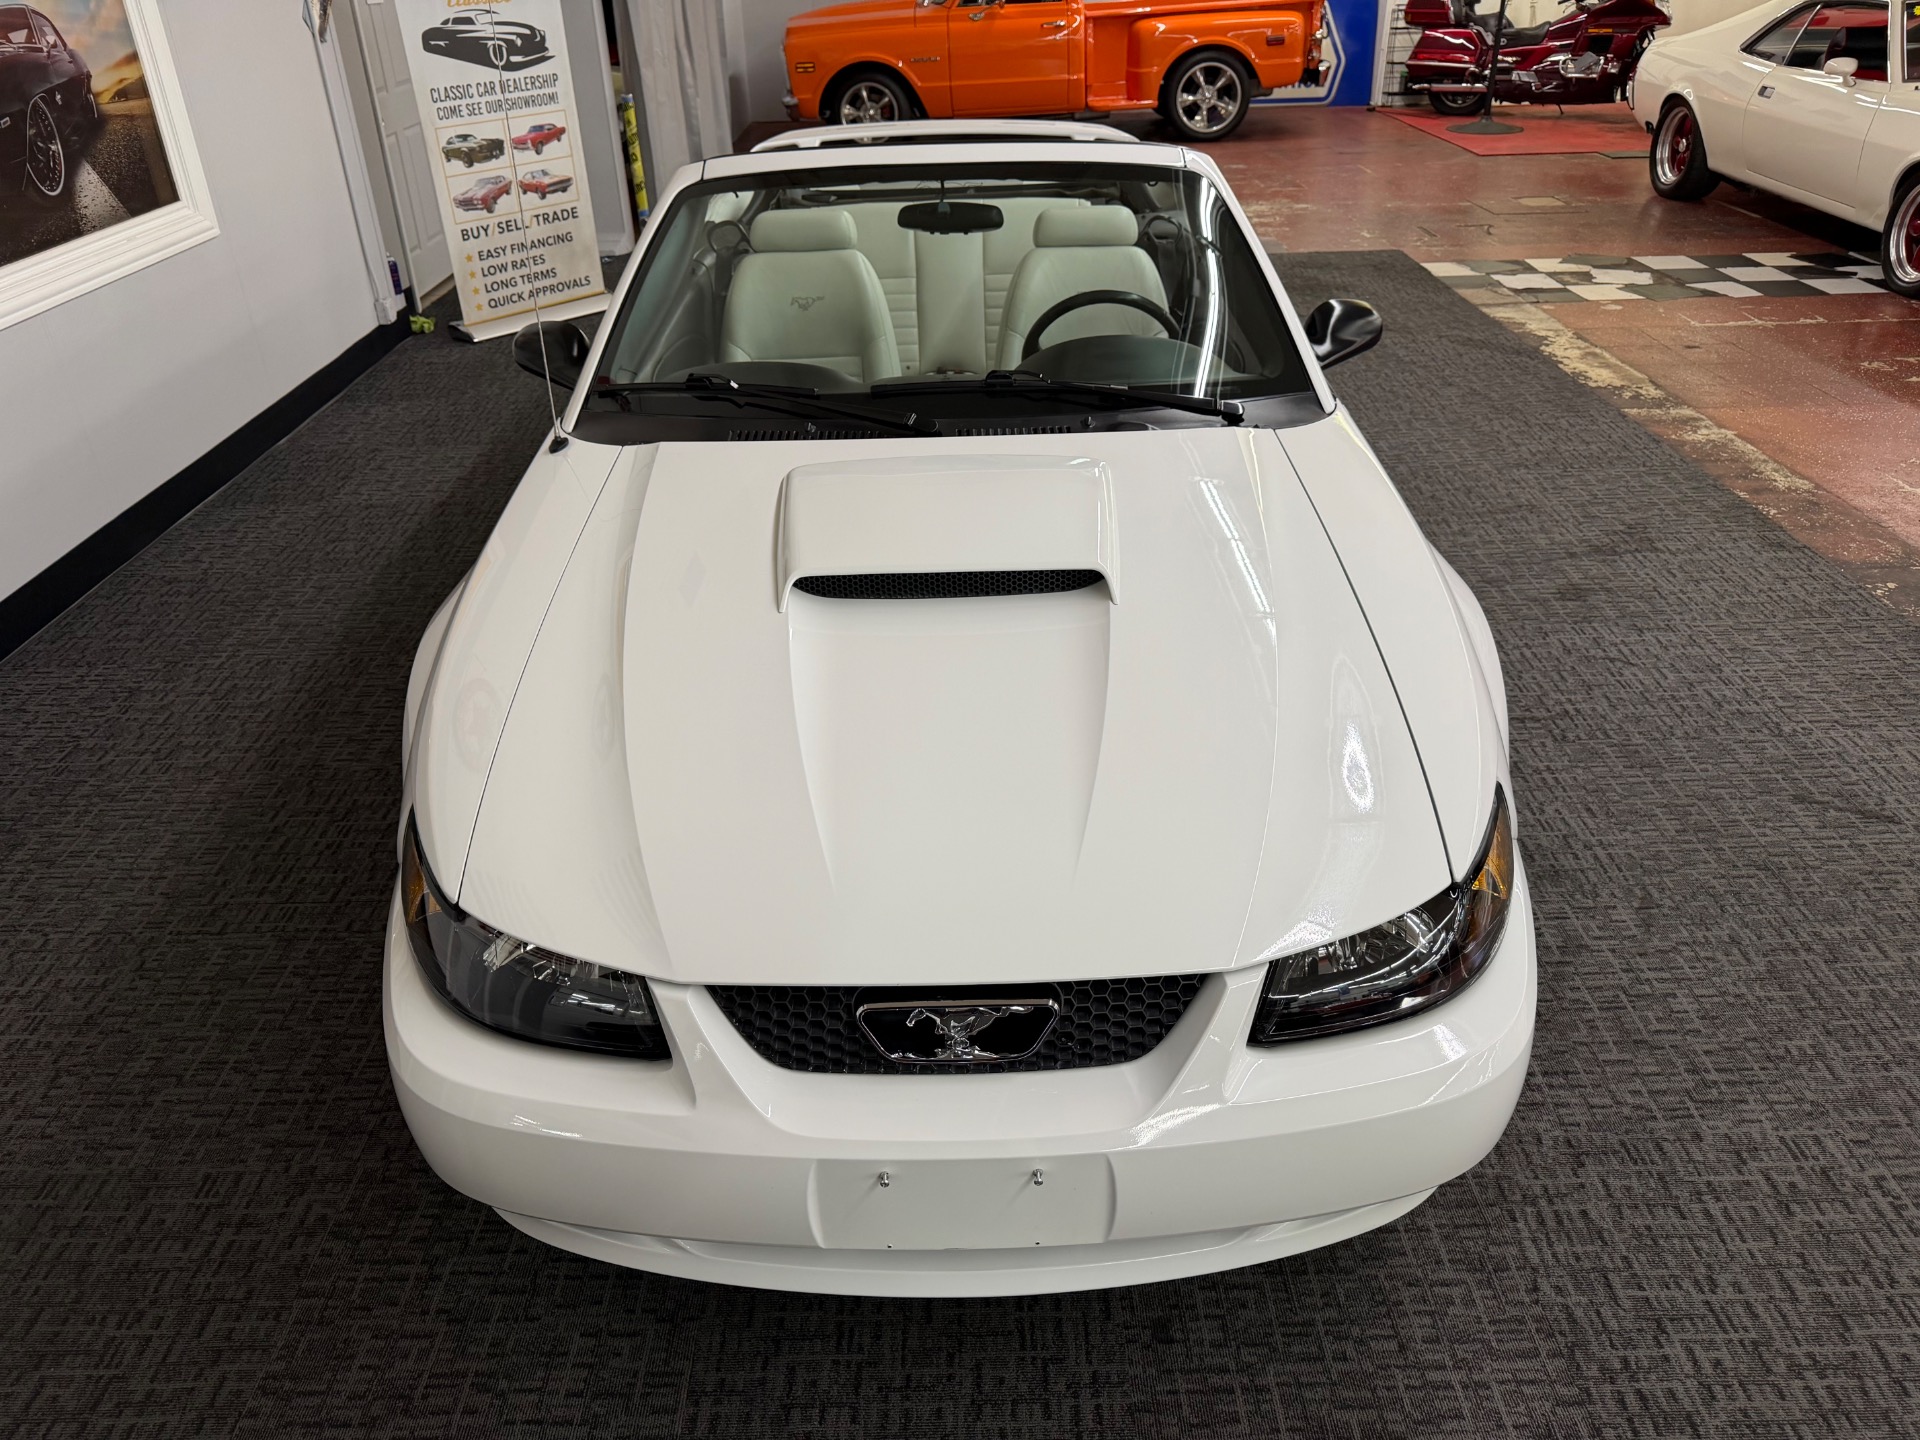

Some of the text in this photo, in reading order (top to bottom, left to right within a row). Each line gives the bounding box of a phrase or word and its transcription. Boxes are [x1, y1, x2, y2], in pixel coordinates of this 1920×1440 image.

[430, 73, 559, 103] CLASSIC CAR DEALERSHIP
[436, 91, 560, 120] COME SEE OUR SHOWROOM!
[477, 231, 574, 261] EASY FINANCING
[481, 262, 508, 278] LOW
[484, 267, 558, 294] LONG TERMS
[488, 275, 591, 309] QUICK APPROVALS
